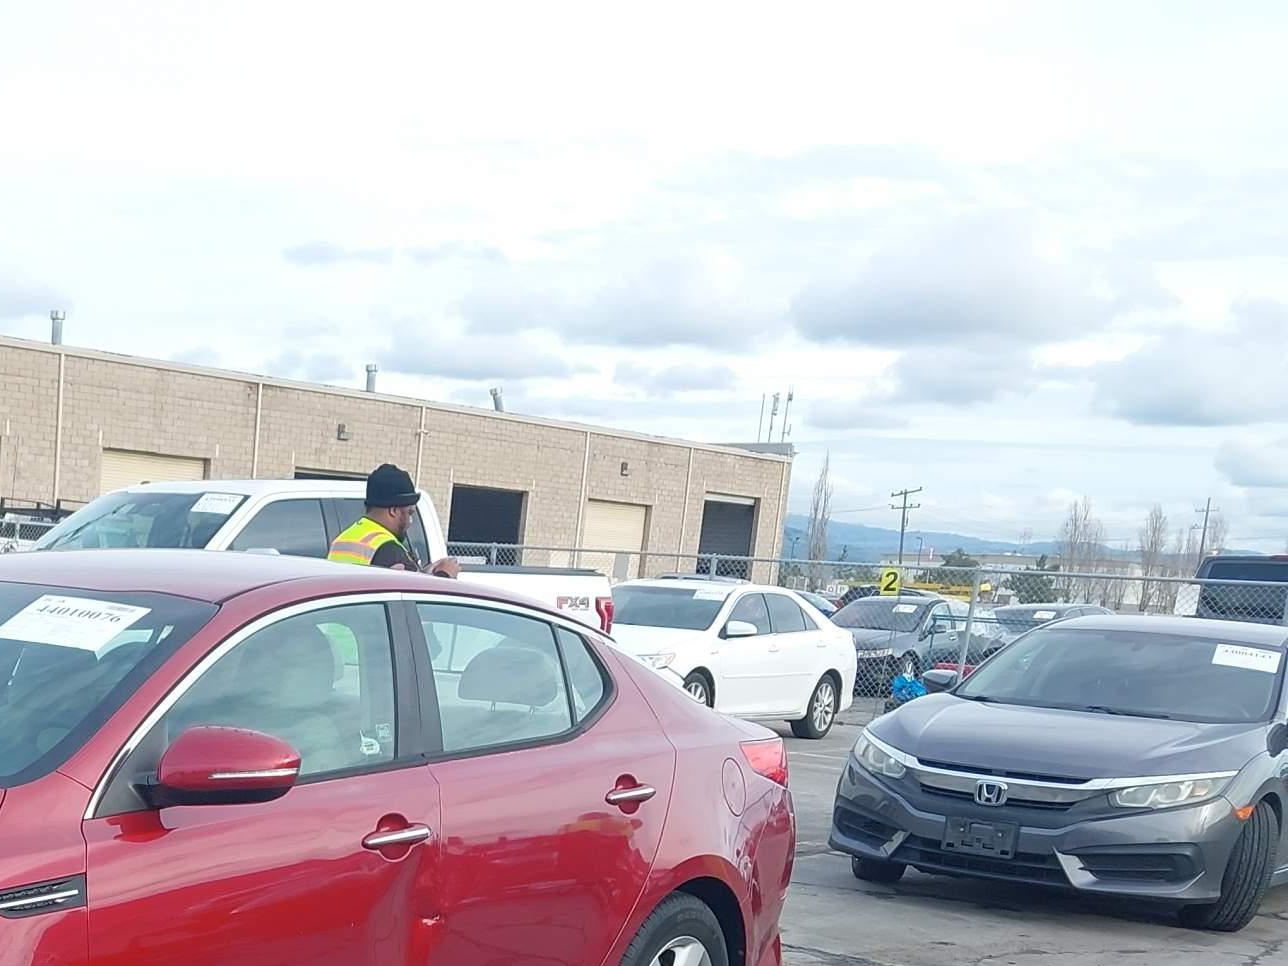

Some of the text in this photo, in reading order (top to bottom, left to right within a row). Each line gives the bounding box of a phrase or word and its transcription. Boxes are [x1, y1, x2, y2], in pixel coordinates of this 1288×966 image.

[883, 571, 899, 592] 2
[556, 596, 589, 609] FX4
[37, 604, 121, 623] 44010076
